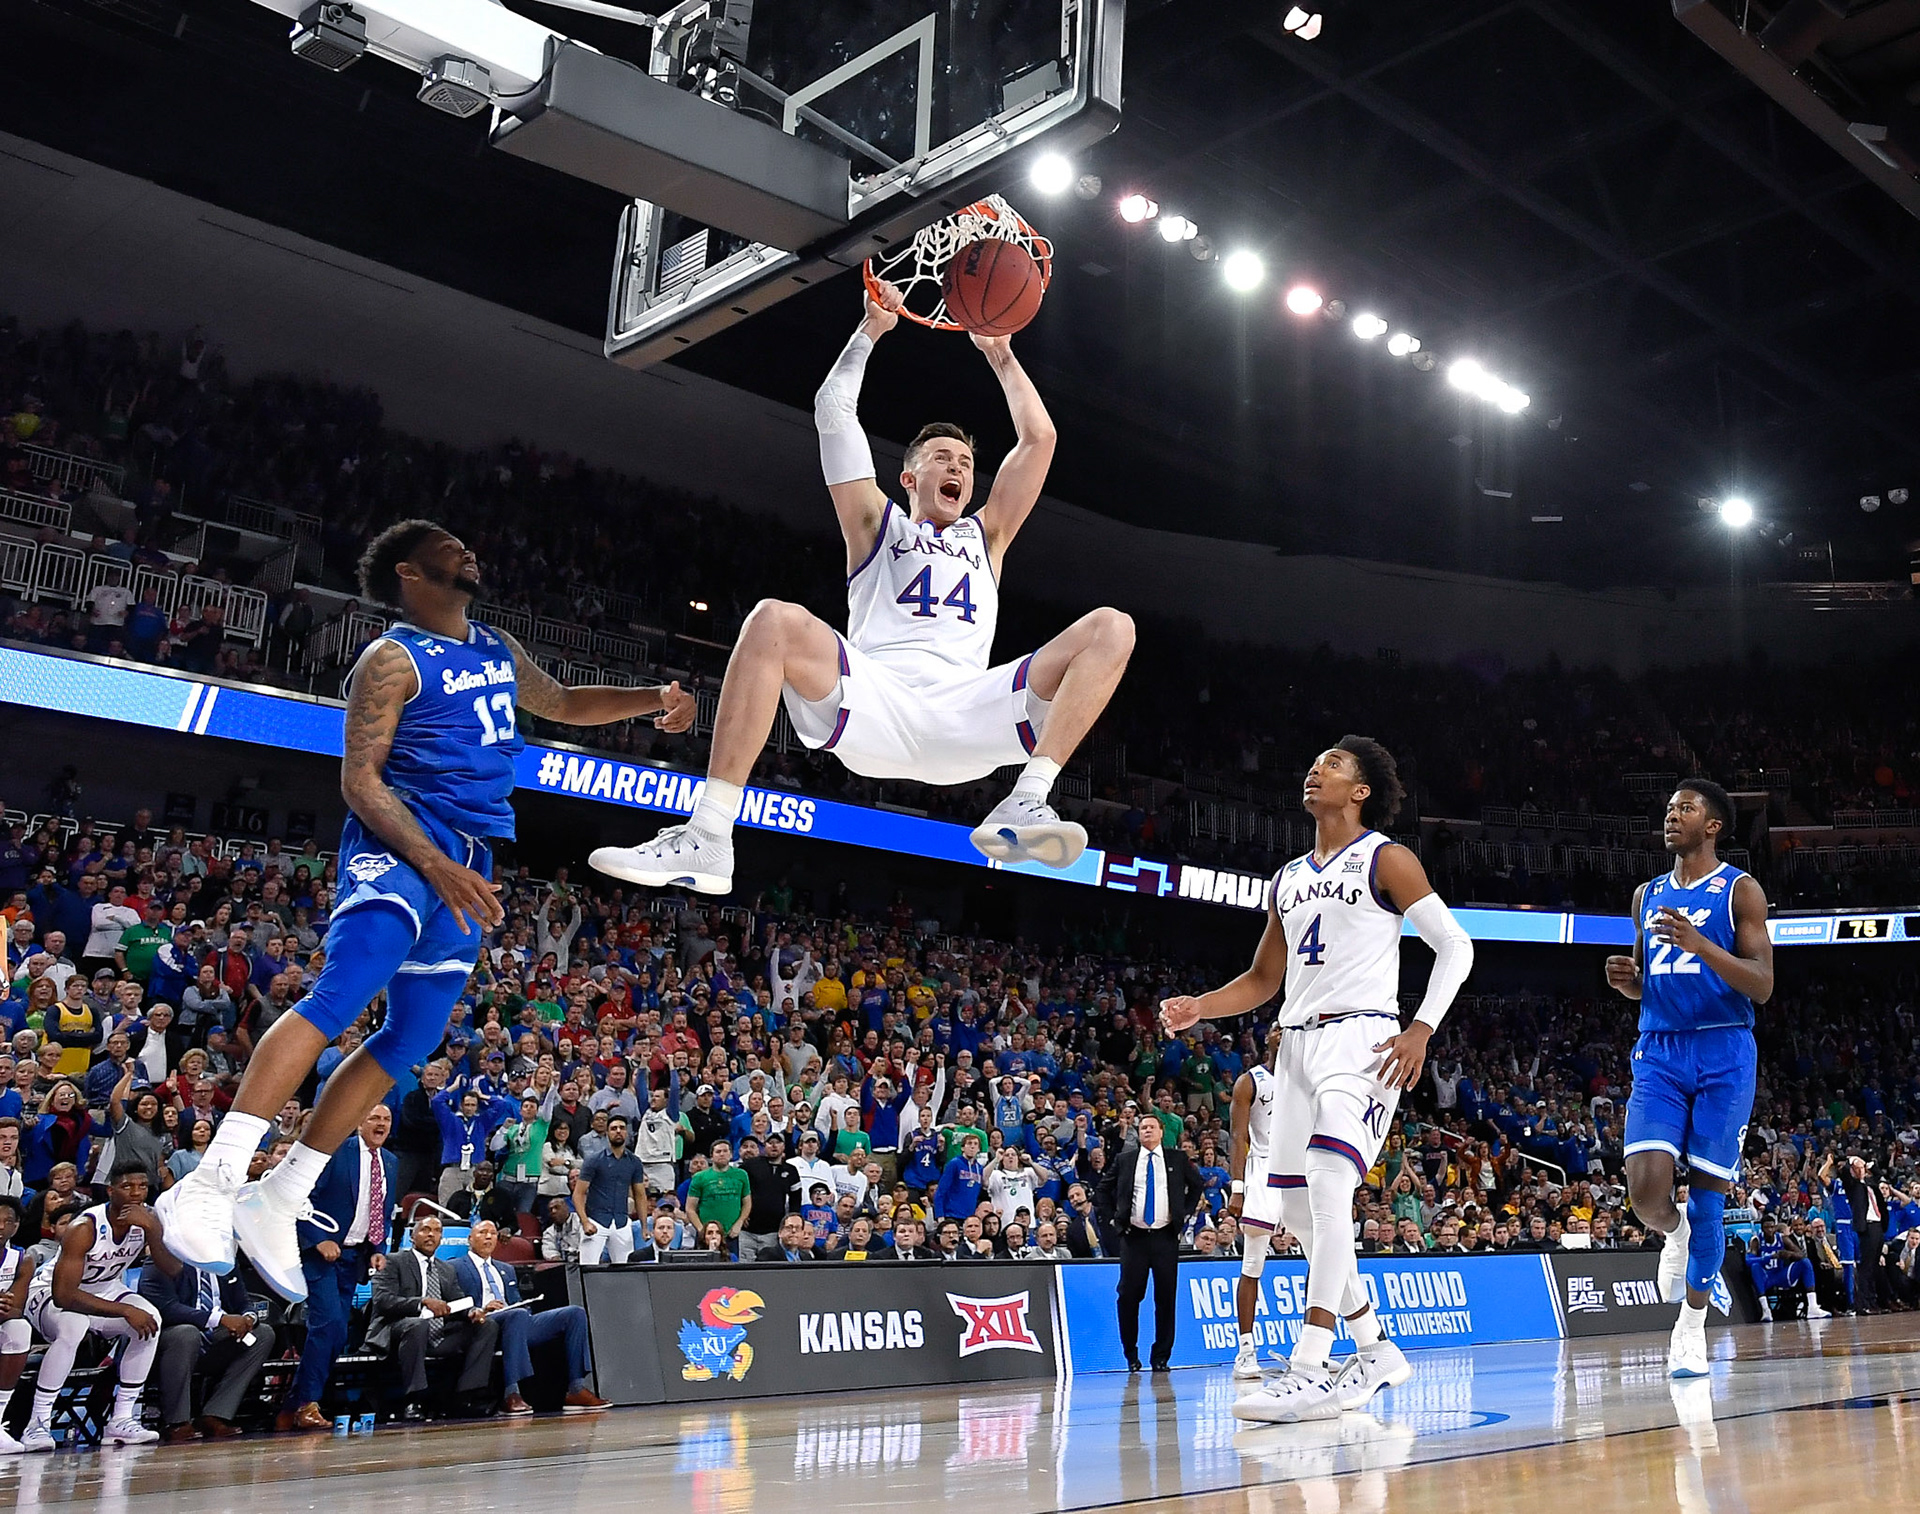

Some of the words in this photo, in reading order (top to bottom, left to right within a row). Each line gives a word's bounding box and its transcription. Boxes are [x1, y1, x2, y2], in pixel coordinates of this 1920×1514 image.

[964, 240, 985, 277] NCA
[889, 535, 982, 570] KANSAS
[896, 564, 978, 625] 44
[441, 668, 487, 695] Seton
[481, 660, 515, 685] Hall
[472, 692, 516, 747] 13
[537, 752, 816, 833] #MARCHMNESS
[1297, 913, 1327, 966] 4
[1780, 925, 1822, 936] KANSAS
[1849, 920, 1878, 938] 75
[1649, 934, 1701, 976] 22
[1004, 1110, 1017, 1121] 23
[920, 1152, 931, 1167] 4
[1272, 1272, 1381, 1315] SED
[1383, 1271, 1468, 1309] ROUND
[1567, 1276, 1594, 1291] BIG
[1568, 1291, 1606, 1304] EAST
[1612, 1280, 1660, 1307] SETON
[701, 1336, 728, 1357] KU
[799, 1310, 925, 1354] KANSAS
[1202, 1321, 1264, 1350] HOSTD
[1264, 1320, 1287, 1346] BY
[1395, 1310, 1473, 1337] UNIVERSITY
